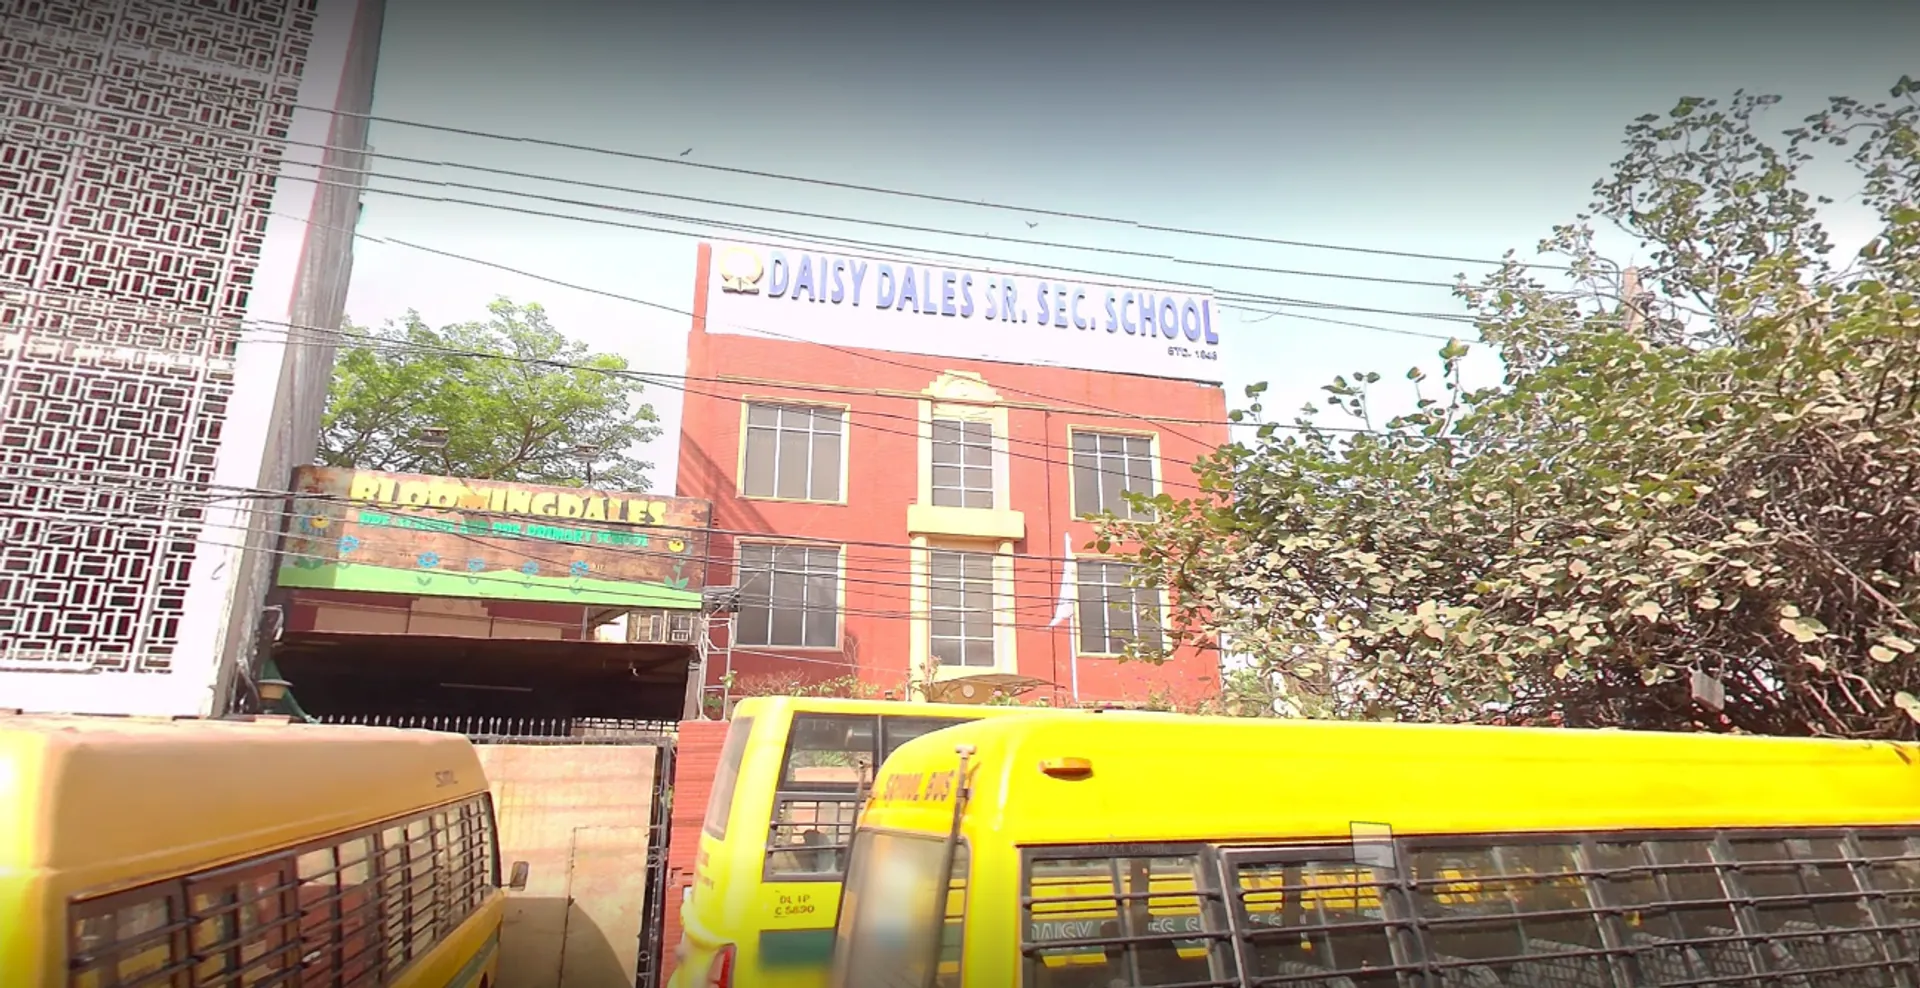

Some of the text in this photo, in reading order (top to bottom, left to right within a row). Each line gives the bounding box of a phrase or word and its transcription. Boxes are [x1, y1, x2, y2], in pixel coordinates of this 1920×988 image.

[768, 251, 1219, 345] DAISY DALES SR. SEC. SCHOOL
[349, 472, 667, 525] BLOOMINGDALES
